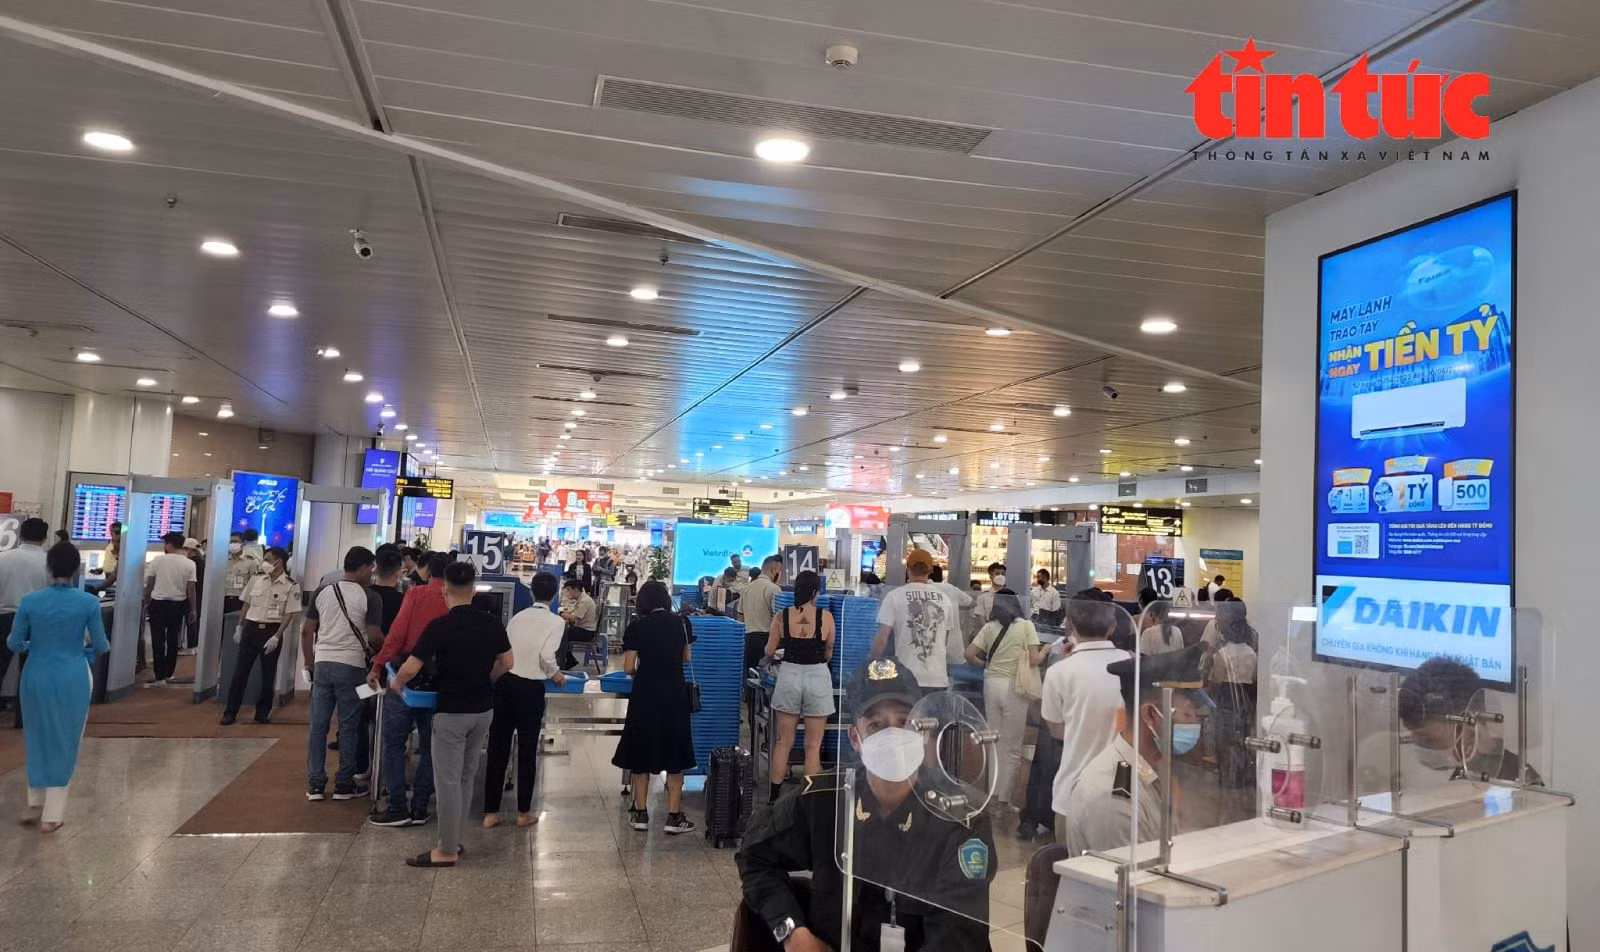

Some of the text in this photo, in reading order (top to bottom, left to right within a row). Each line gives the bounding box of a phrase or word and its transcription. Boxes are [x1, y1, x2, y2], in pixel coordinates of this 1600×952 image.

[1358, 296, 1392, 319] LẠNH
[1330, 320, 1379, 341] TRAO TAY
[1364, 303, 1499, 372] TIỀN TỶ
[1328, 345, 1362, 363] NHẬN
[1328, 363, 1360, 379] NGAY
[1407, 477, 1429, 500] TỶ
[1456, 484, 1487, 499] 500
[992, 512, 1020, 521] LOTUS
[468, 535, 502, 570] 15
[702, 547, 743, 557] VietinB
[788, 549, 816, 580] 14
[1146, 567, 1174, 599] 13
[905, 590, 943, 601] SULLEN
[1353, 596, 1502, 637] DAIKIN
[1321, 637, 1351, 650] CHUYÊN
[1352, 641, 1365, 650] GIA
[1366, 642, 1394, 655] KHÔNG
[1481, 656, 1502, 670] BẢN
